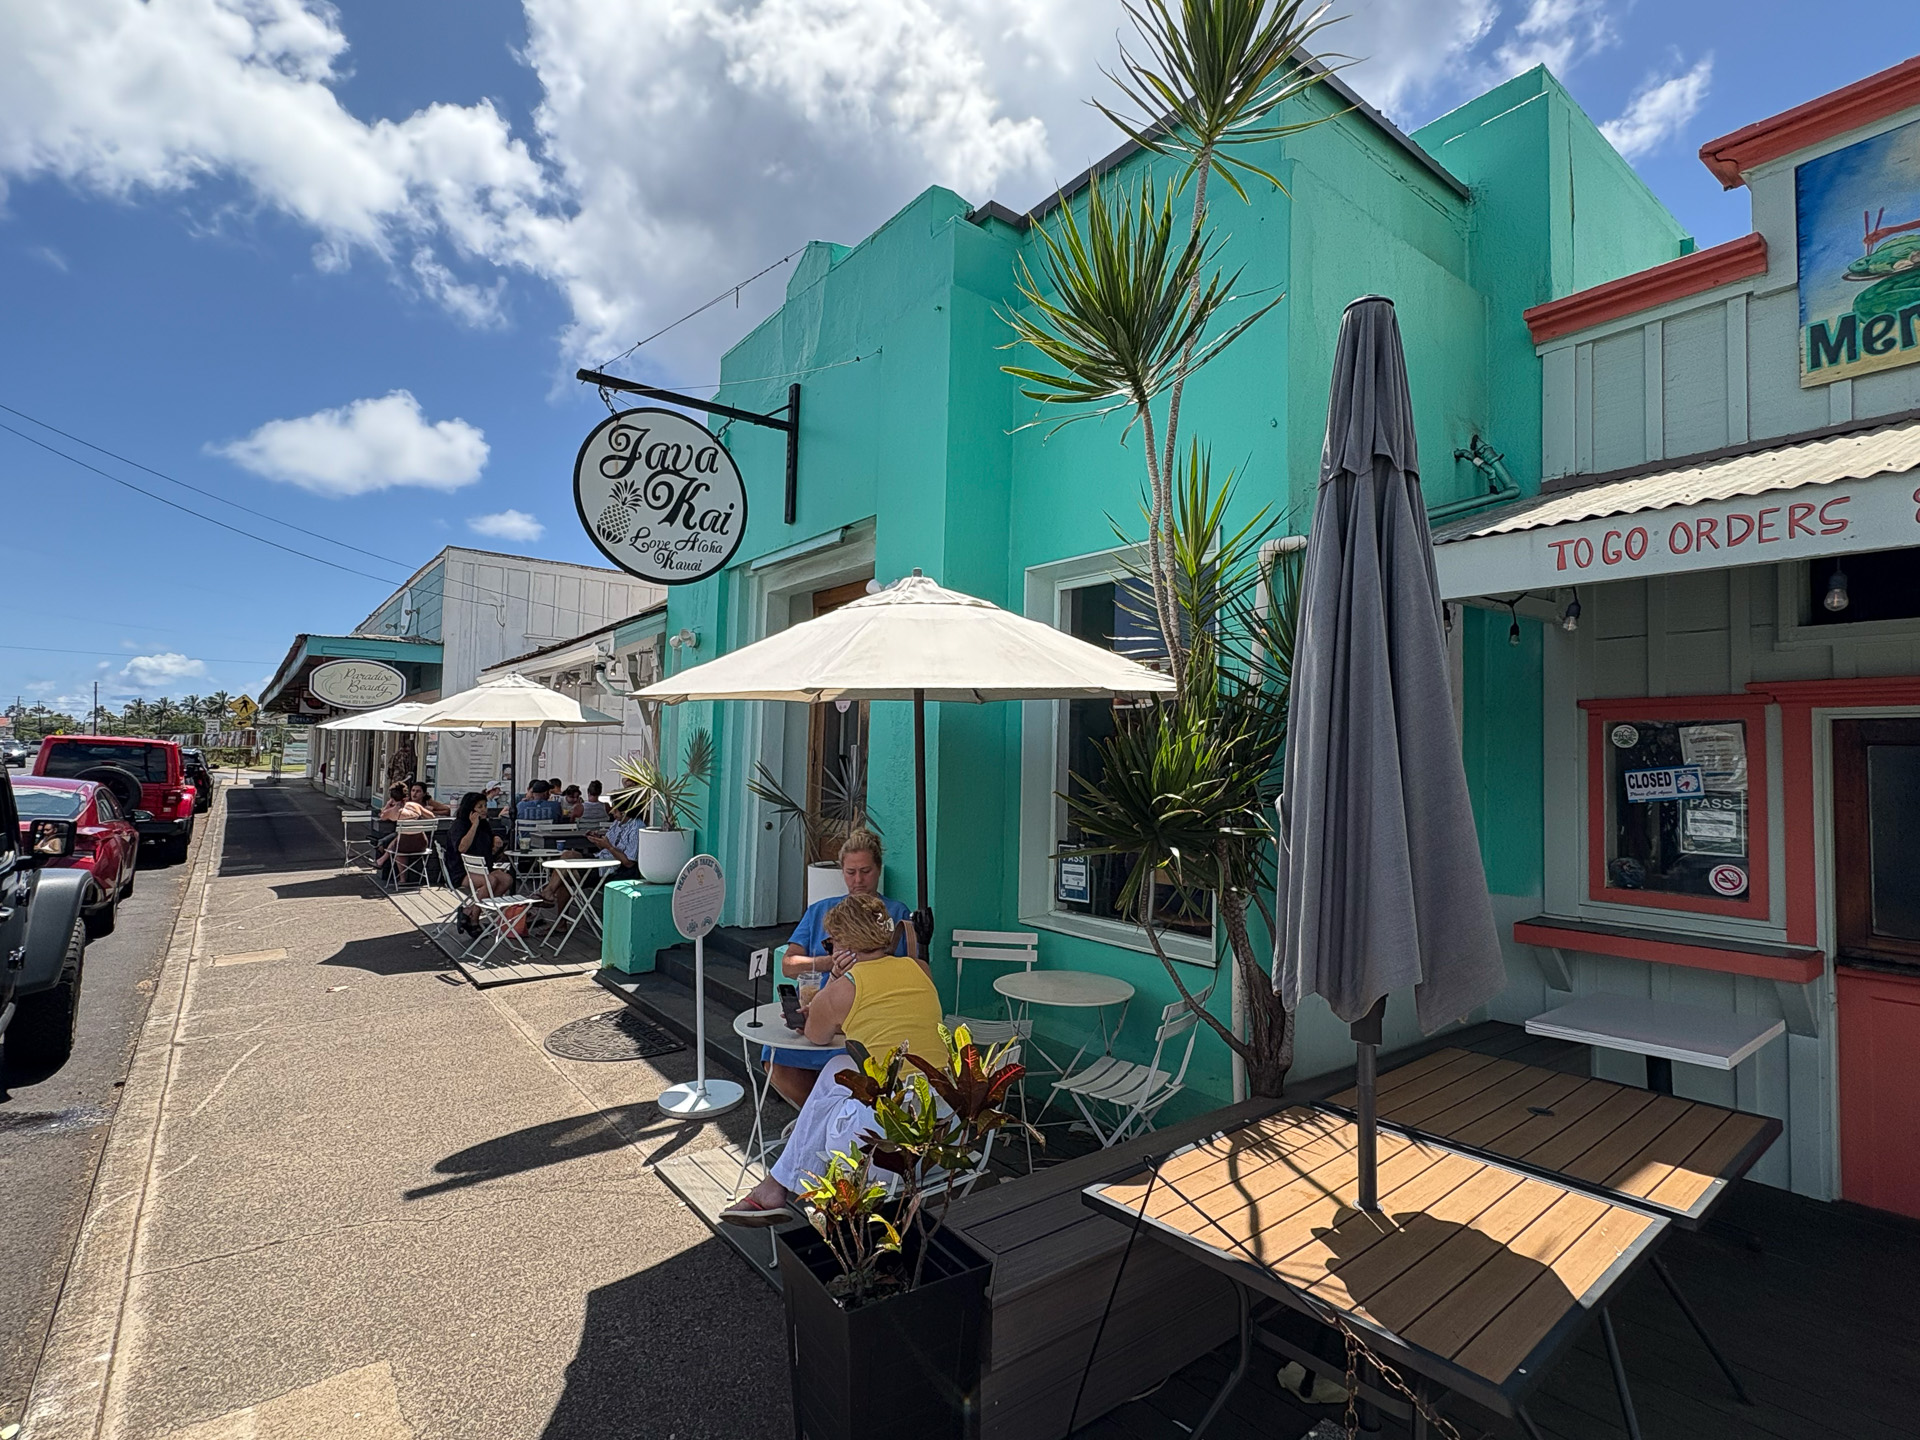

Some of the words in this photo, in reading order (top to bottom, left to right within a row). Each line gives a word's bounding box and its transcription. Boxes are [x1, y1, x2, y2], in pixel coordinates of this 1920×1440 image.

[599, 423, 719, 479] Java
[644, 469, 735, 535] Kai
[1669, 496, 1851, 555] ORDERS
[629, 527, 671, 553] Love
[675, 531, 723, 554] Aloha
[653, 549, 703, 571] Kauai
[343, 668, 393, 682] Paradise
[347, 680, 398, 698] Beauty
[1628, 771, 1672, 789] CLOSED
[1690, 798, 1733, 809] PASS
[677, 873, 688, 891] REAL
[756, 953, 763, 971] 7
